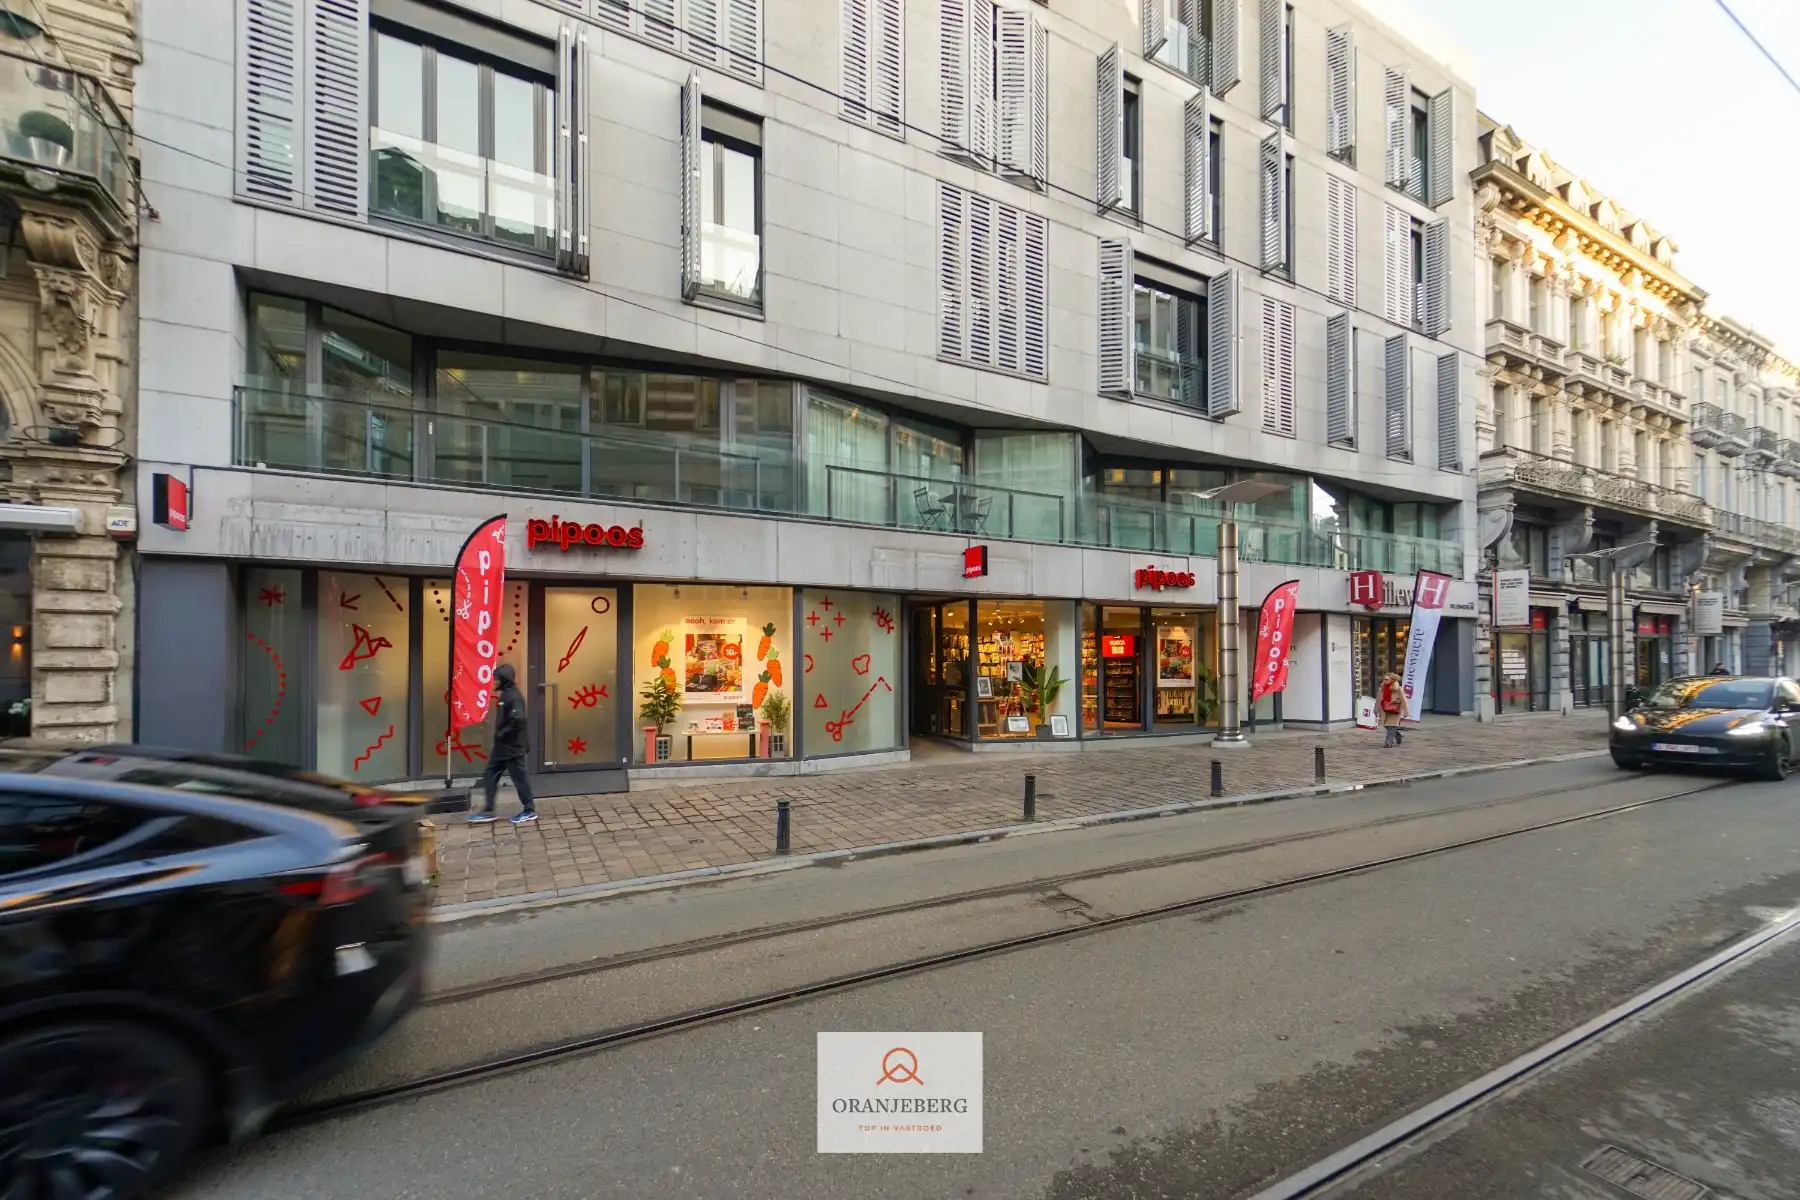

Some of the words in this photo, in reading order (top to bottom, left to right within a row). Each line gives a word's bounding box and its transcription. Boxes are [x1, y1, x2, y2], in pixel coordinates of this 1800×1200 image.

[111, 519, 130, 527] ADT
[527, 515, 644, 551] pipoos
[1135, 565, 1195, 590] pipoos
[1417, 575, 1446, 605] H
[476, 550, 494, 708] pipoos
[1267, 598, 1285, 686] pipoos
